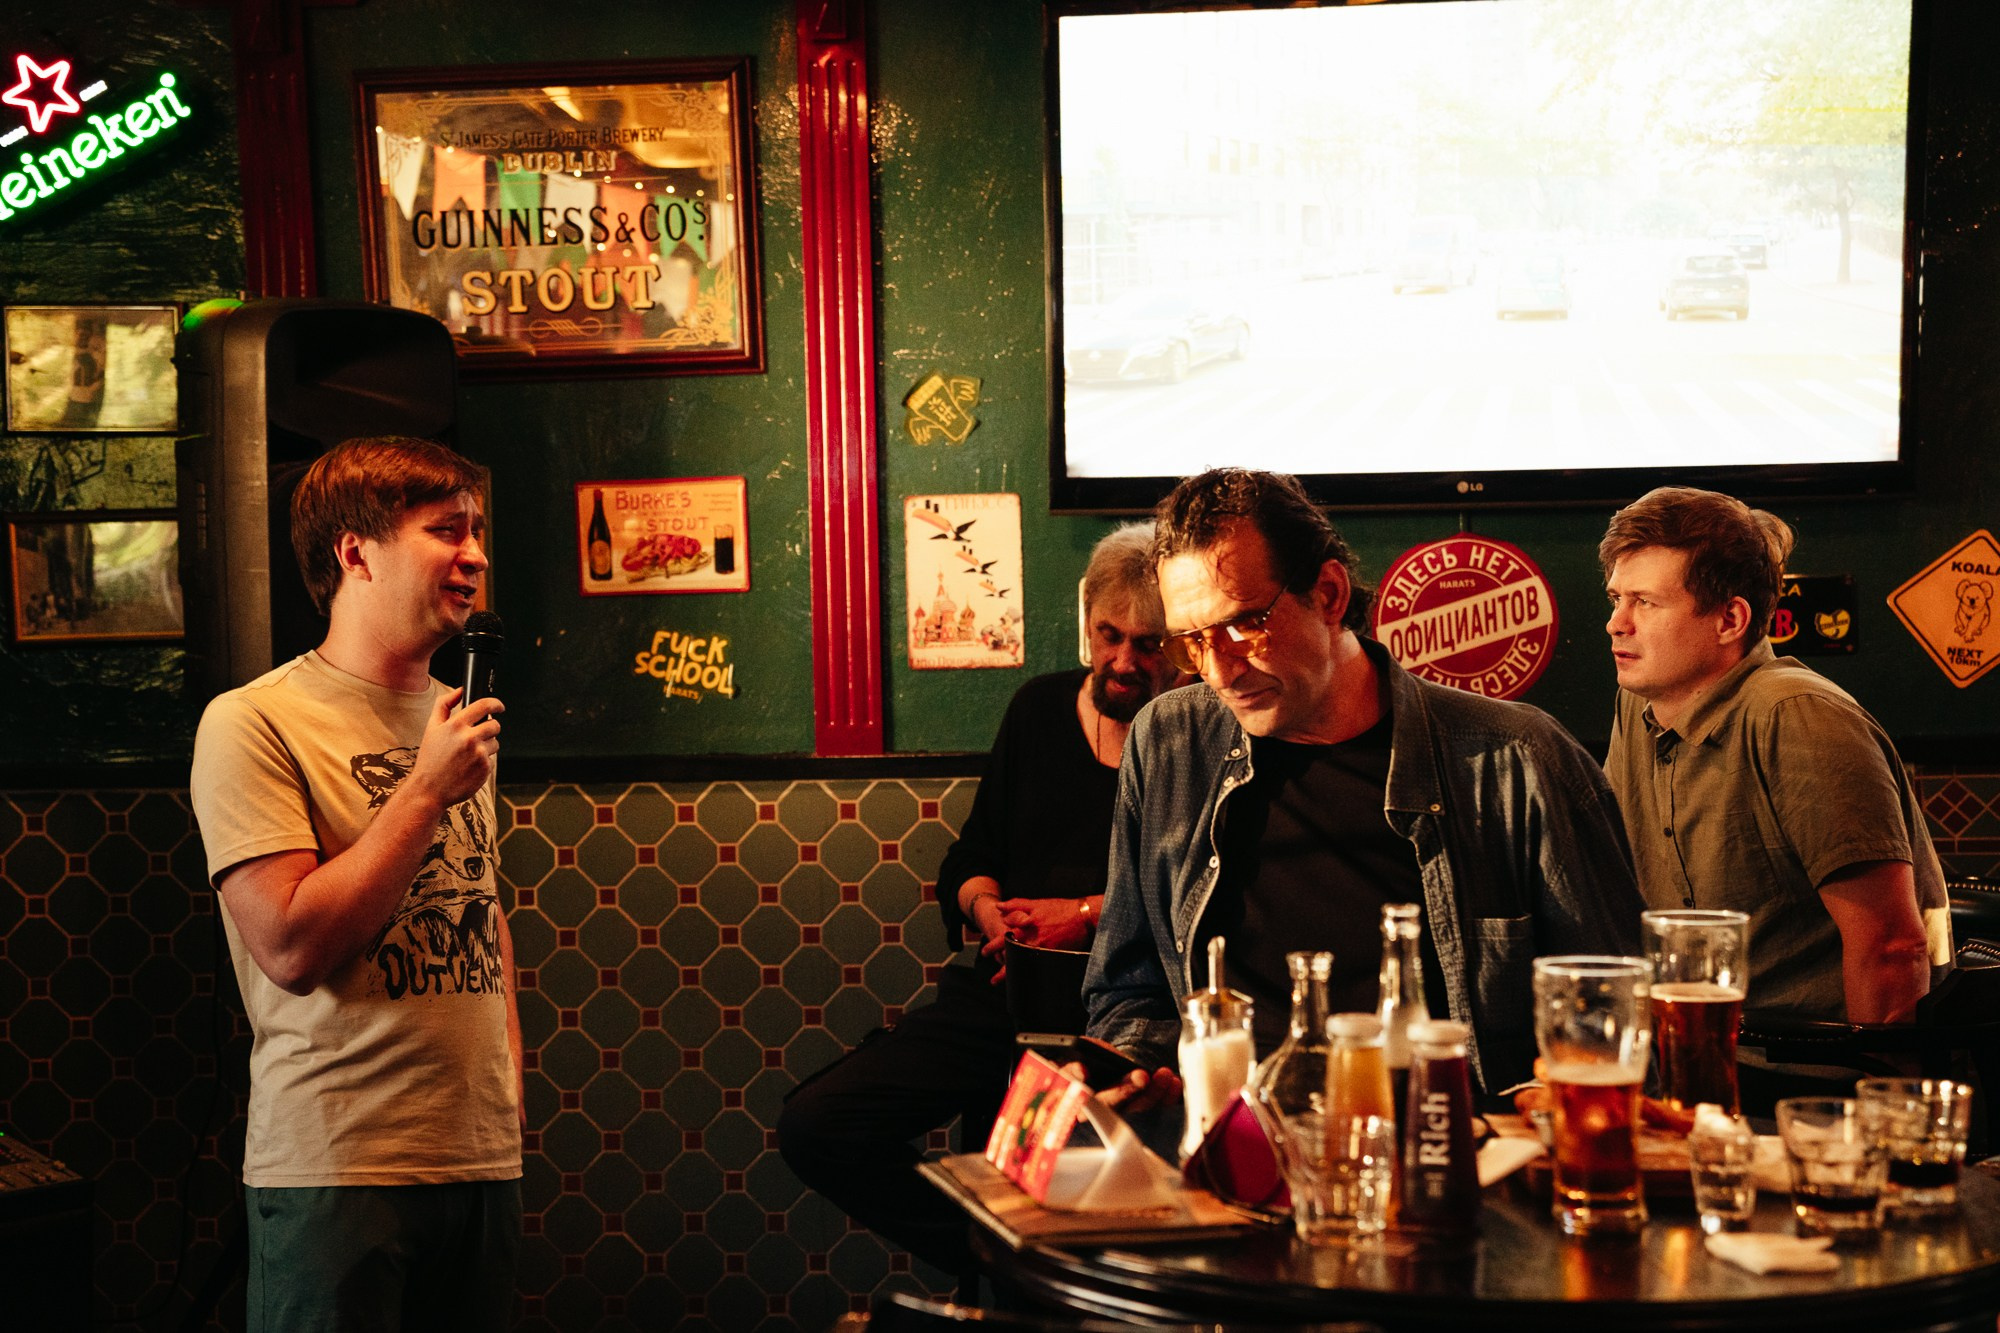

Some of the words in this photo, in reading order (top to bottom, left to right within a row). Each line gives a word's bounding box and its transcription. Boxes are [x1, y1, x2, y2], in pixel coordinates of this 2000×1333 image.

[0, 73, 191, 220] eineken
[502, 150, 617, 174] DUBLIN
[461, 265, 660, 315] STOUT
[647, 516, 709, 533] STOUT
[1386, 547, 1458, 612] ЗДЕСЬ
[1469, 545, 1520, 581] НЕТ
[651, 630, 728, 665] FUCK
[1390, 586, 1539, 663] ОФИЦИАНТОВ
[634, 651, 734, 694] SCHOOL
[1470, 637, 1540, 698] ЗДЕСЬ
[1947, 647, 1984, 658] NEXT
[1419, 1092, 1451, 1166] Rich
